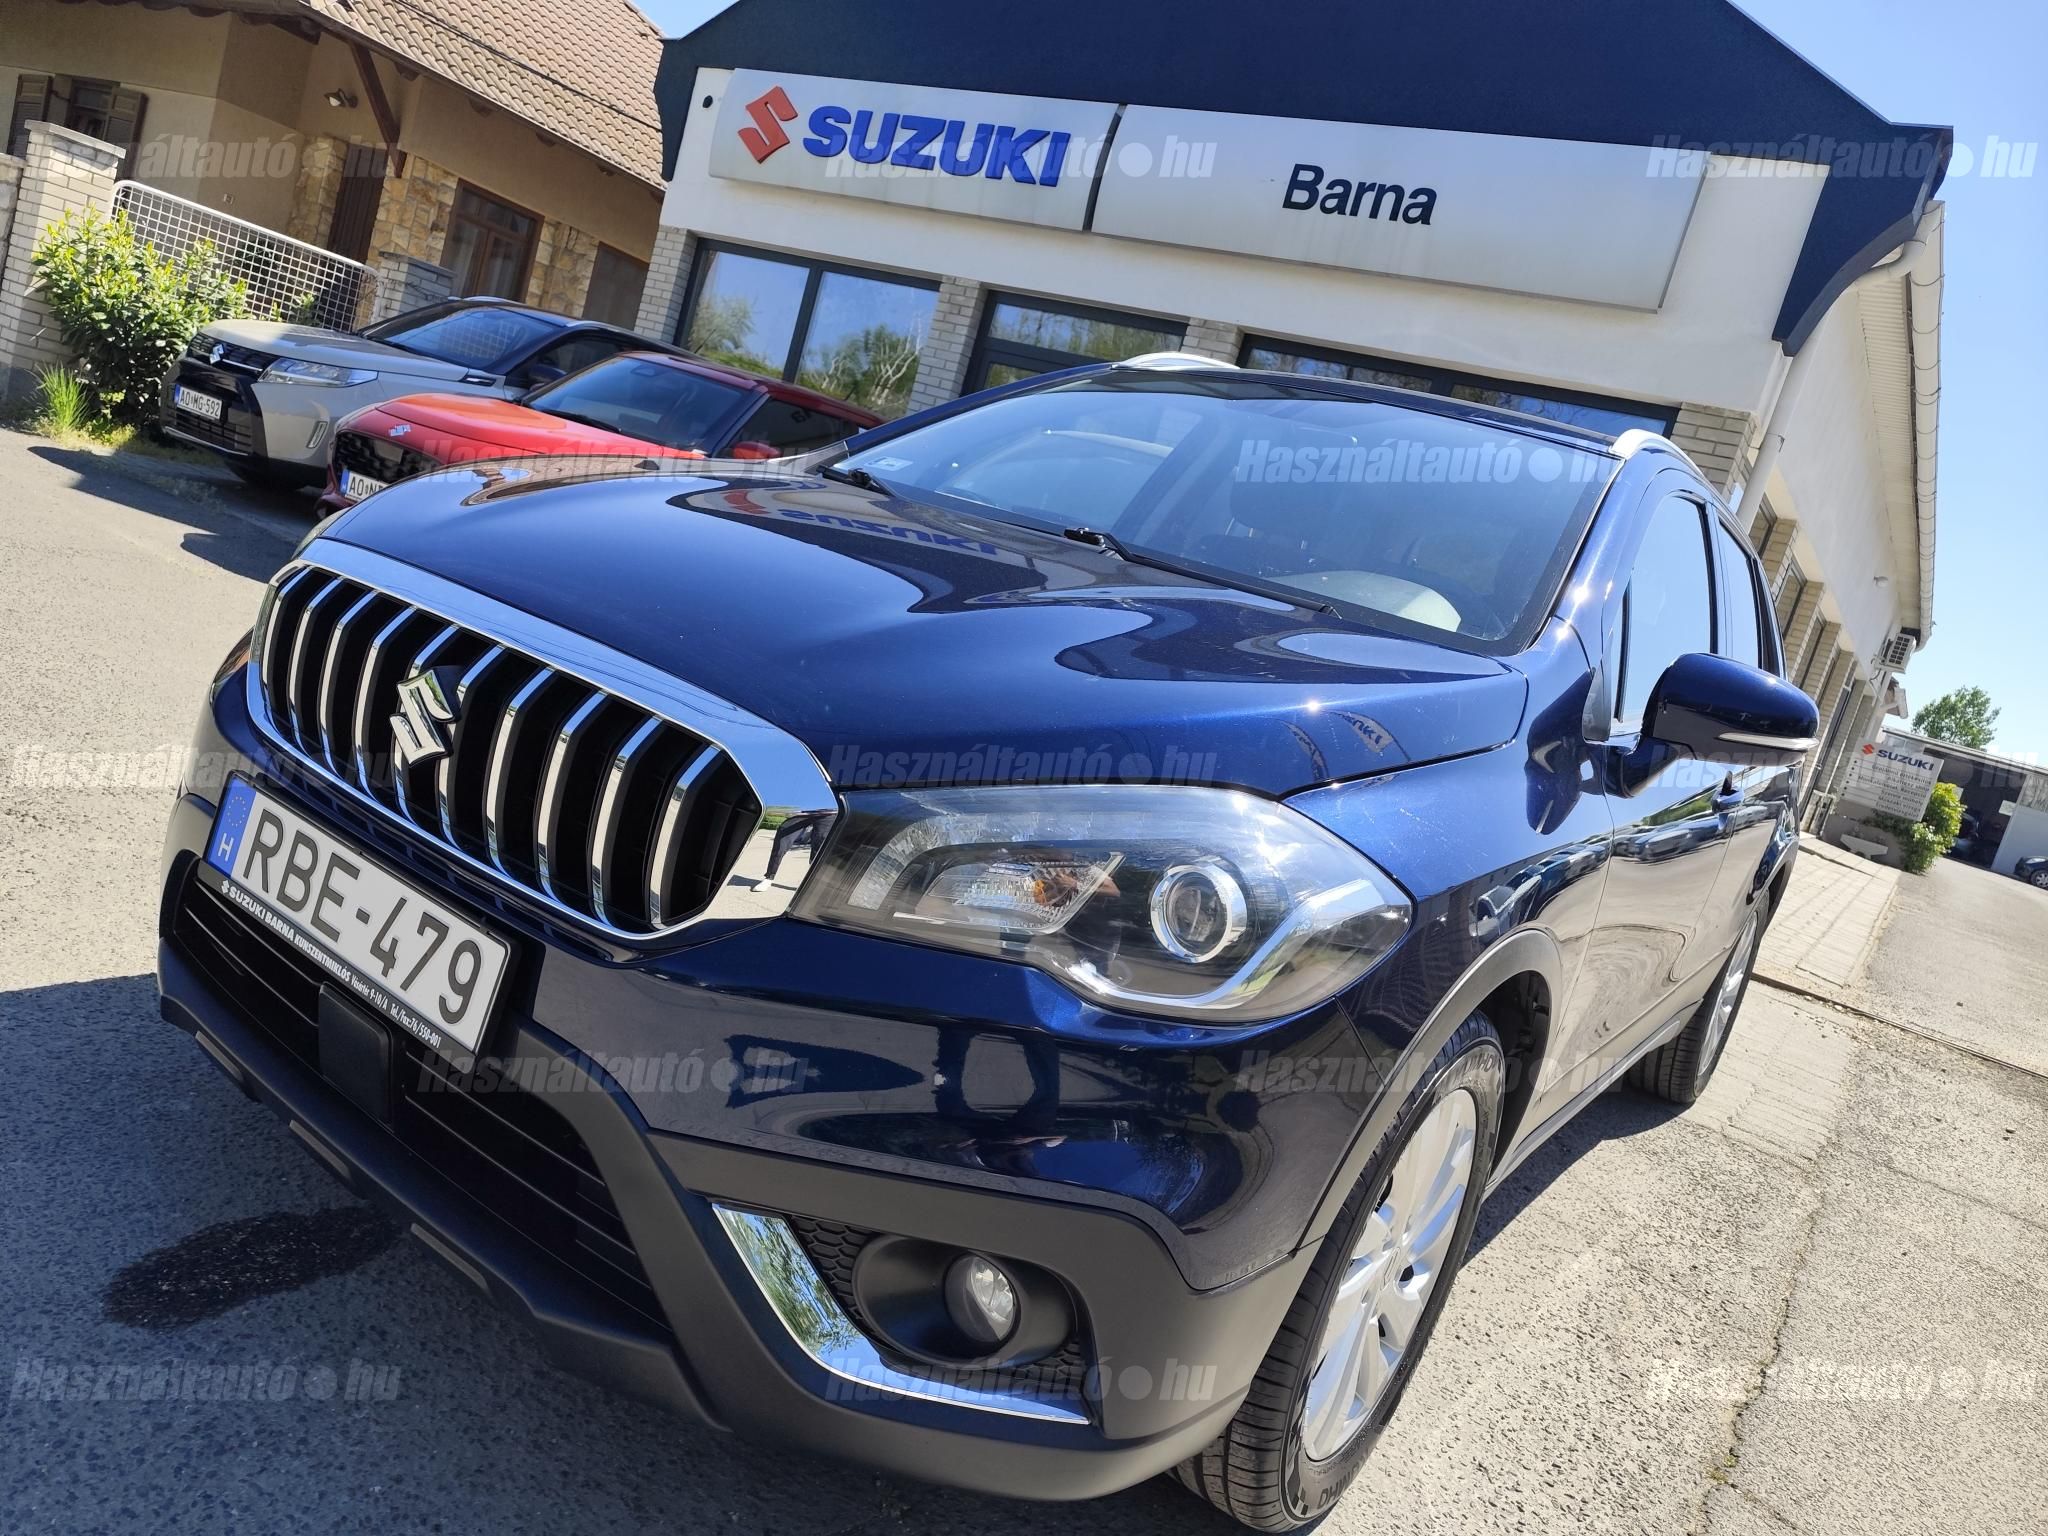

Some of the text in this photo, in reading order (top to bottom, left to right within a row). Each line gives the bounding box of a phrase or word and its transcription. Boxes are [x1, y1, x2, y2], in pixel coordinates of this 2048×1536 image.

[803, 106, 1071, 187] SUZUKI
[1282, 163, 1437, 225] Barna
[1877, 749, 1934, 771] SUZUKI
[229, 886, 266, 920] SUZUKI
[264, 912, 296, 941] BARNA
[294, 933, 352, 982] KUNSZENTMIKLÓS
[243, 808, 482, 1024] RBE-479
